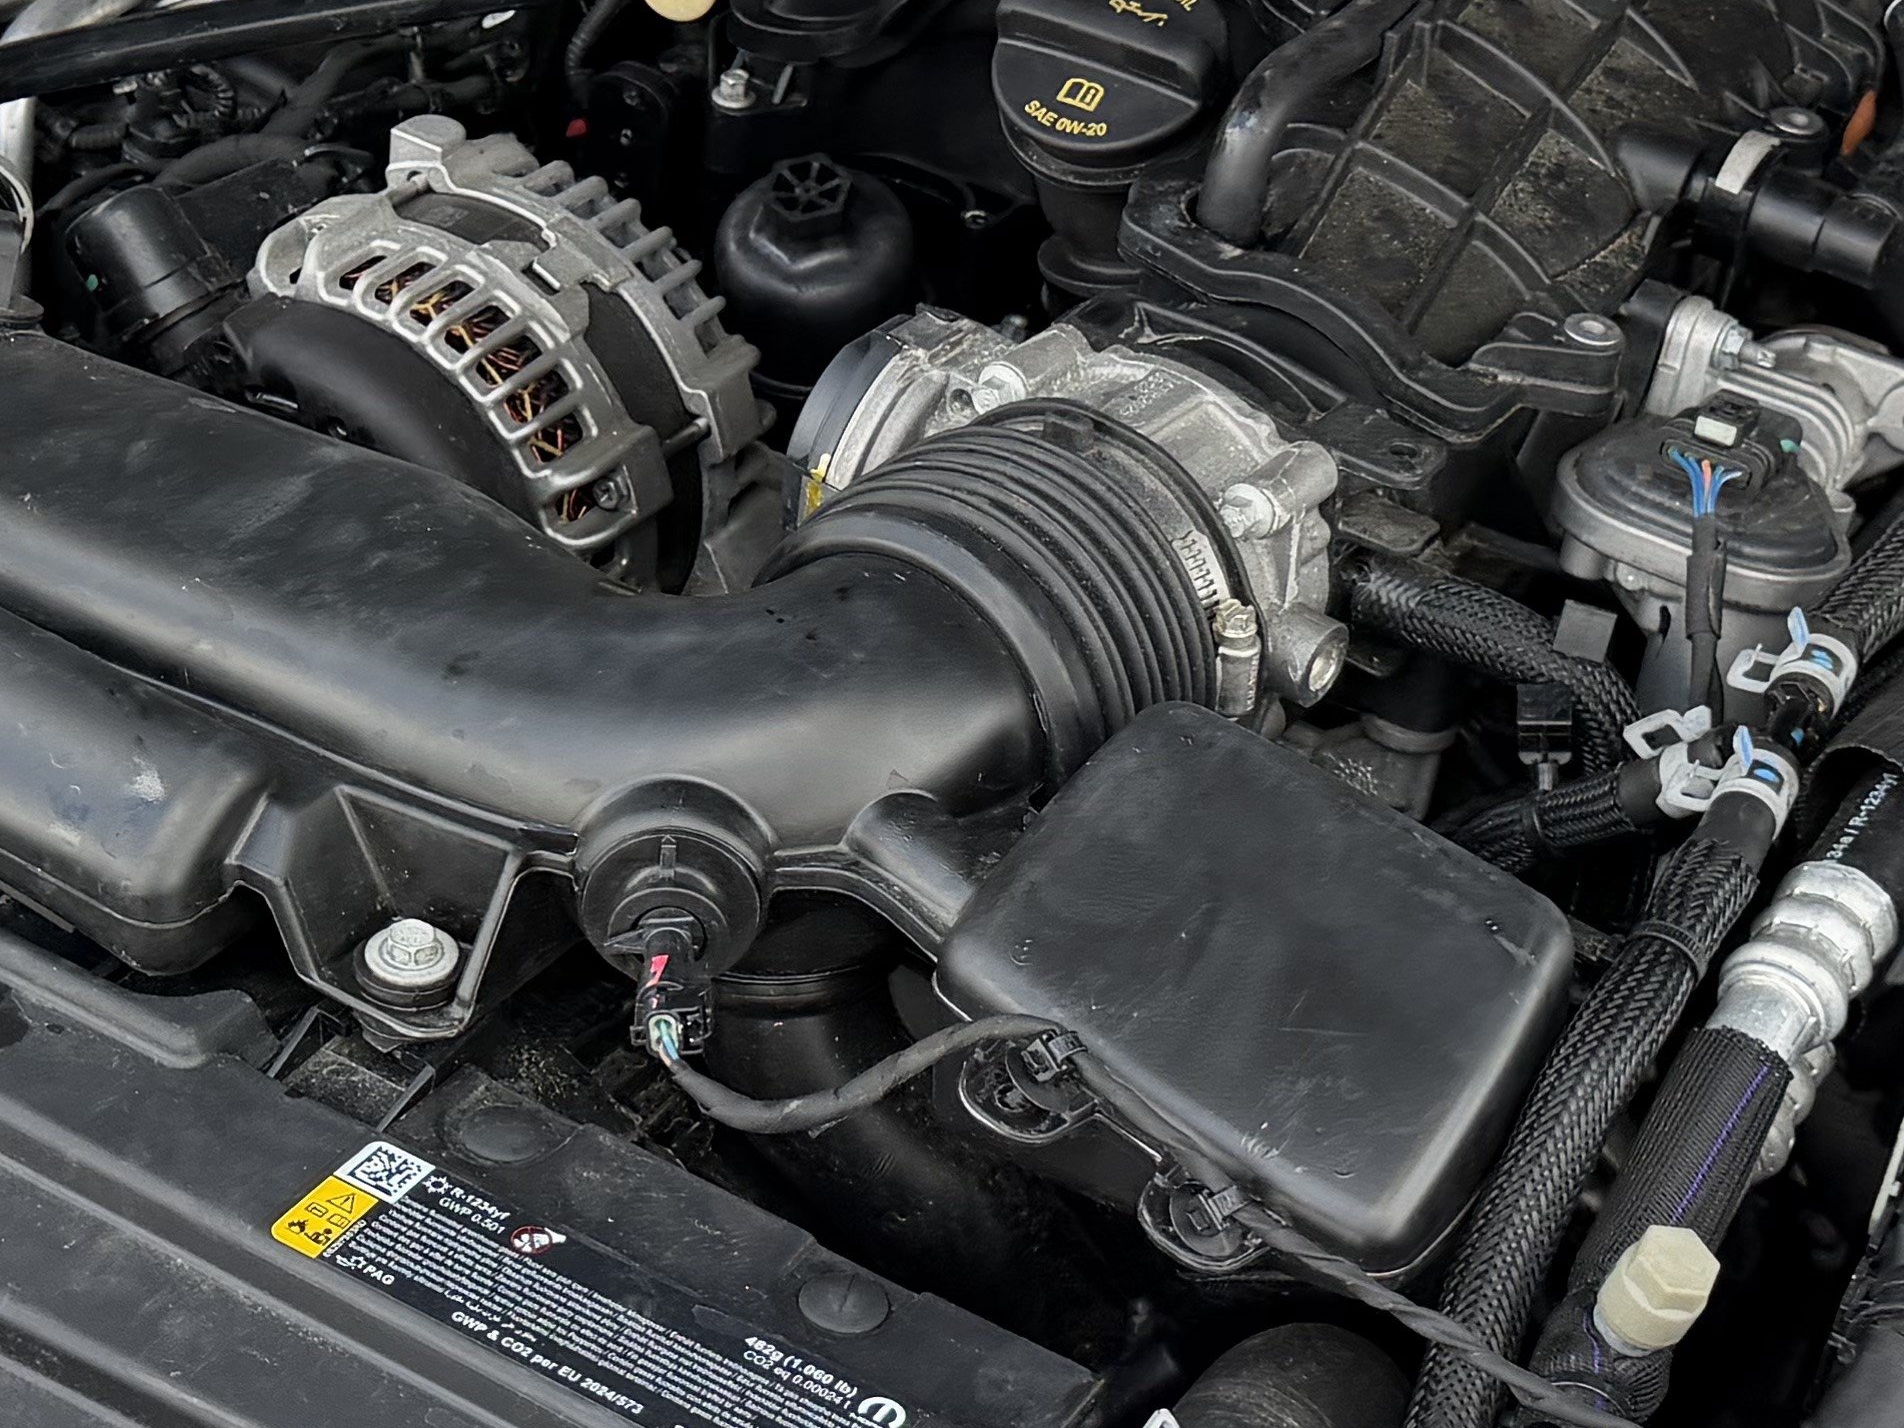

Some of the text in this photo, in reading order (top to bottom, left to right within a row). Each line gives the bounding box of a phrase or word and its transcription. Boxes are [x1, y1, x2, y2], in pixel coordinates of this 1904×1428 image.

[1024, 101, 1109, 138] SAE 0W-20
[439, 1197, 506, 1234] GWP 0.501
[450, 1187, 511, 1220] R-1234yf
[362, 1264, 395, 1285] PAG
[451, 1311, 488, 1332] GWP
[486, 1329, 500, 1342] &
[500, 1336, 533, 1358] CO2
[557, 1365, 582, 1382] EU
[580, 1377, 644, 1414] 2024/573
[743, 1350, 777, 1370] CO2
[833, 1379, 858, 1399] lb)
